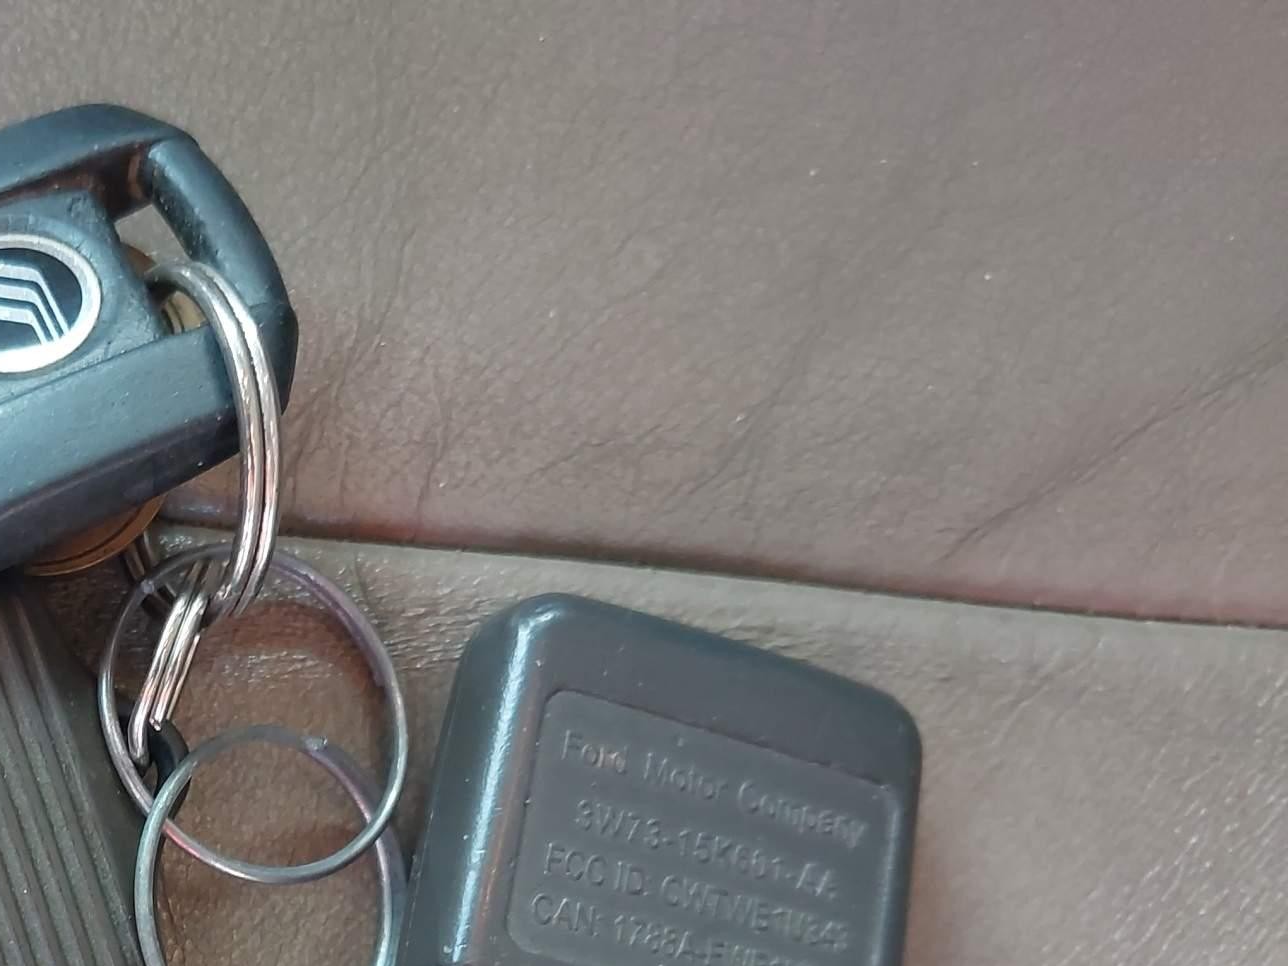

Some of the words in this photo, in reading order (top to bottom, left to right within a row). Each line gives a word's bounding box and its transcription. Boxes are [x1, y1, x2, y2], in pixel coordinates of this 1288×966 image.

[561, 729, 627, 774] Ford
[643, 752, 728, 800] Motor
[738, 779, 868, 849] Company
[543, 841, 606, 886] FCC
[614, 860, 649, 896] ID:
[532, 892, 599, 937] CAN:
